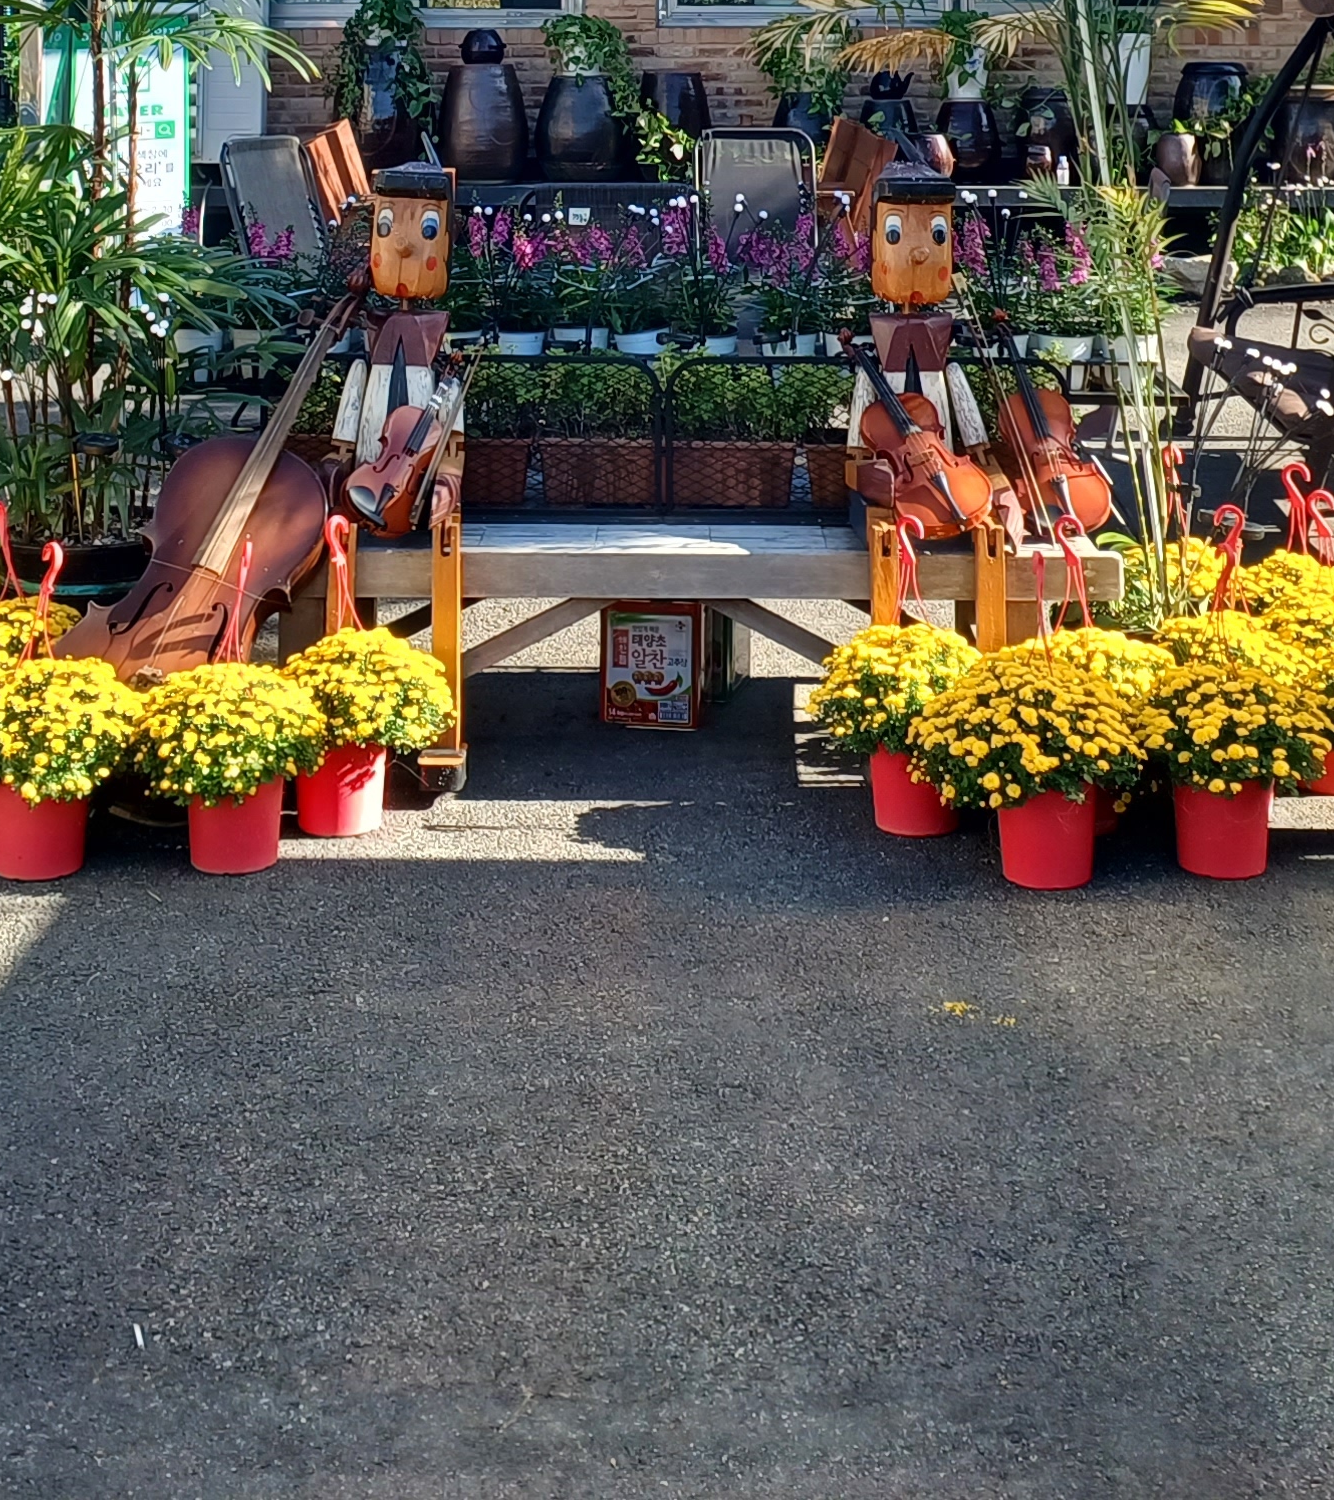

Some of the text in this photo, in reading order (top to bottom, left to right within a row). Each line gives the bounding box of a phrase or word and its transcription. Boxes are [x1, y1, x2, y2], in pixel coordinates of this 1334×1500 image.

[100, 104, 164, 118] AER
[631, 633, 667, 648] 태양초
[631, 647, 667, 670] 알찬
